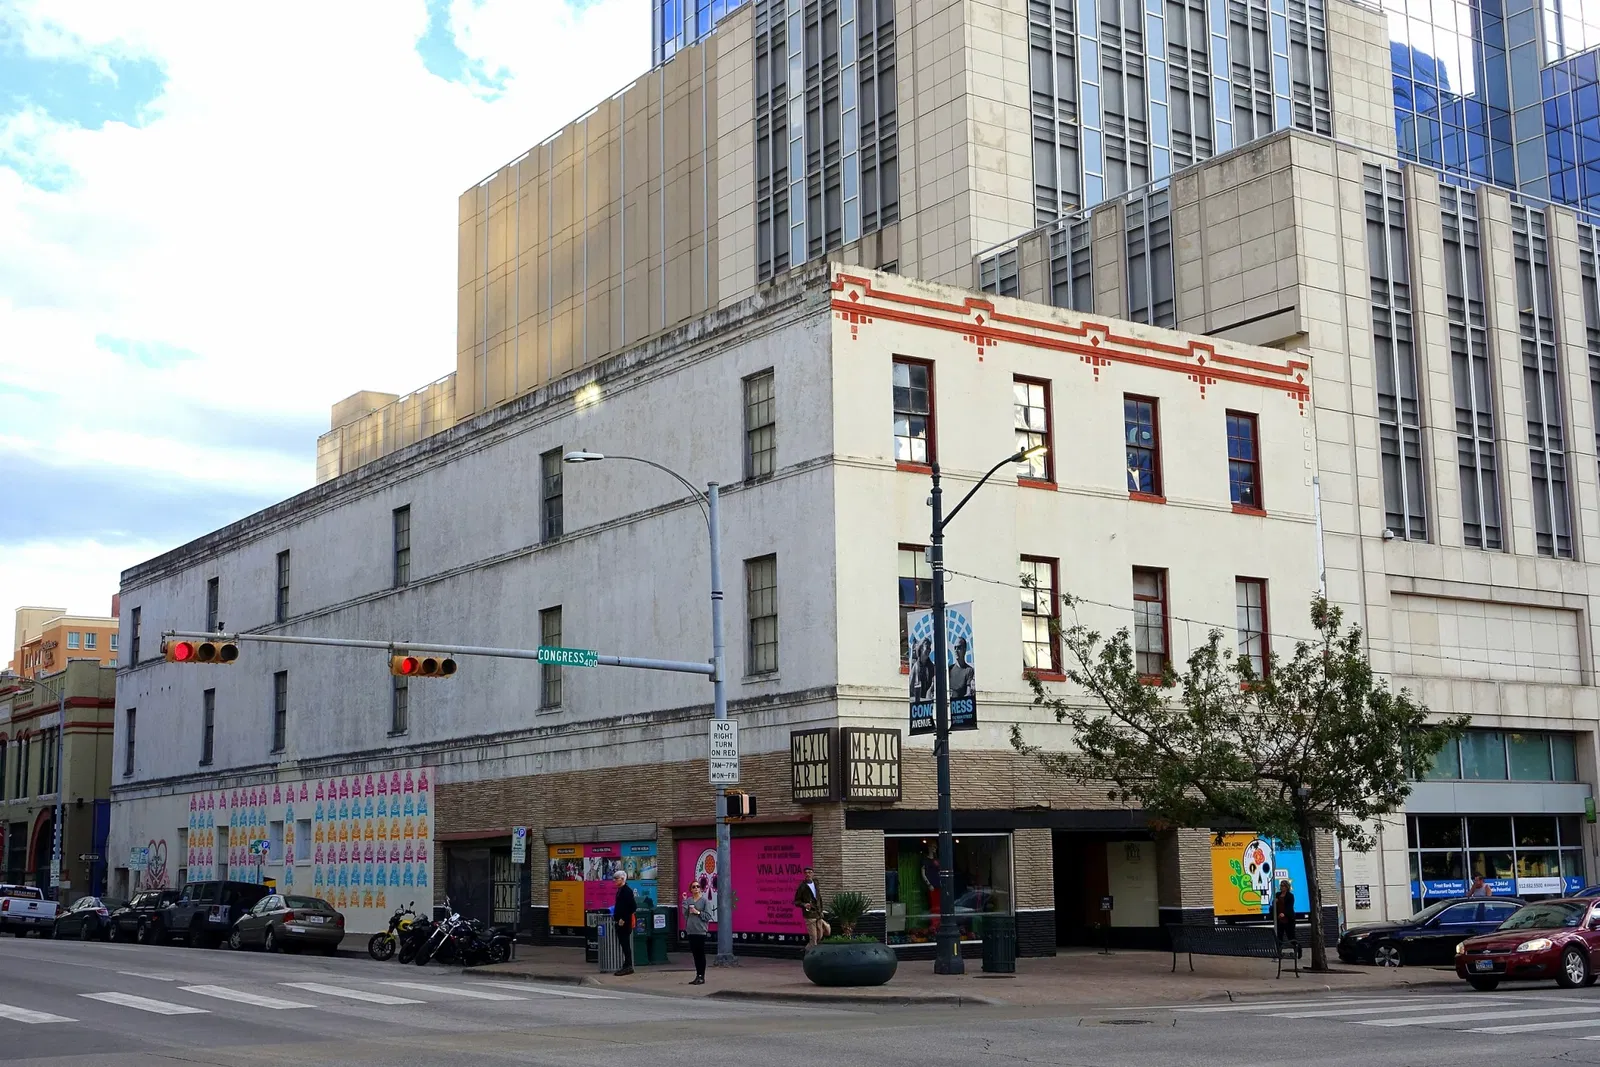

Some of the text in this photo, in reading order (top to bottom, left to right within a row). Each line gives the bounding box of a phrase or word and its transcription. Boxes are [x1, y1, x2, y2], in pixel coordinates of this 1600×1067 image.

[538, 649, 584, 664] CONGRESS
[584, 659, 598, 667] 400
[951, 698, 973, 714] RESS
[716, 723, 730, 731] NO
[911, 718, 932, 728] AVENUE
[713, 732, 733, 740] RIGHT
[793, 733, 829, 762] MEXIC
[850, 732, 899, 760] MEXIC
[711, 749, 737, 757] ON RED
[793, 763, 829, 788] ARTE
[850, 762, 899, 786] ARTE
[794, 788, 830, 799] MUSEUM
[850, 787, 899, 798] MUSEUM
[757, 863, 802, 875] VIVA LA VIDA
